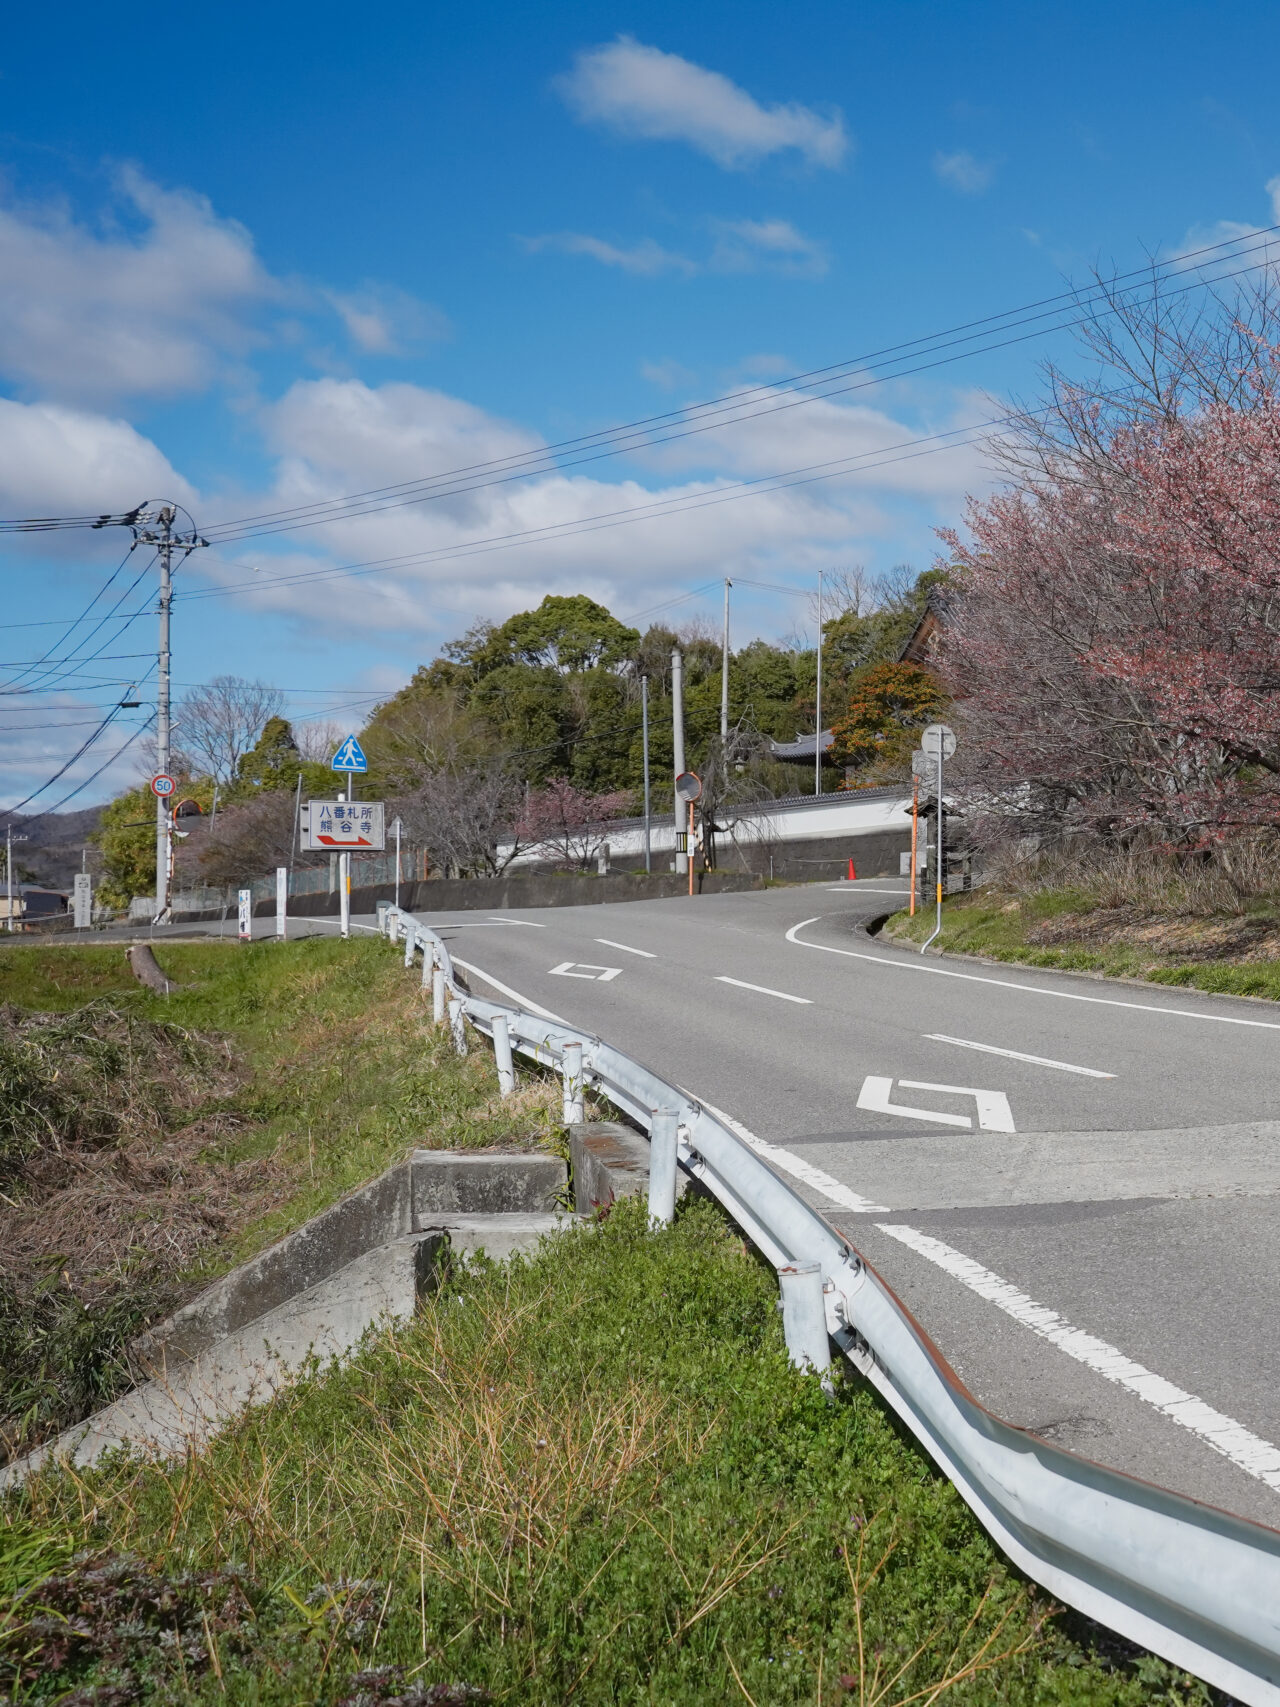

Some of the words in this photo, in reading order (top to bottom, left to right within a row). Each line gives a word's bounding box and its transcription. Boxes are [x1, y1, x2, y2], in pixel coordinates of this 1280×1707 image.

[156, 780, 171, 791] 50
[319, 805, 373, 820] 八番札所
[320, 820, 372, 834] 熊谷寺
